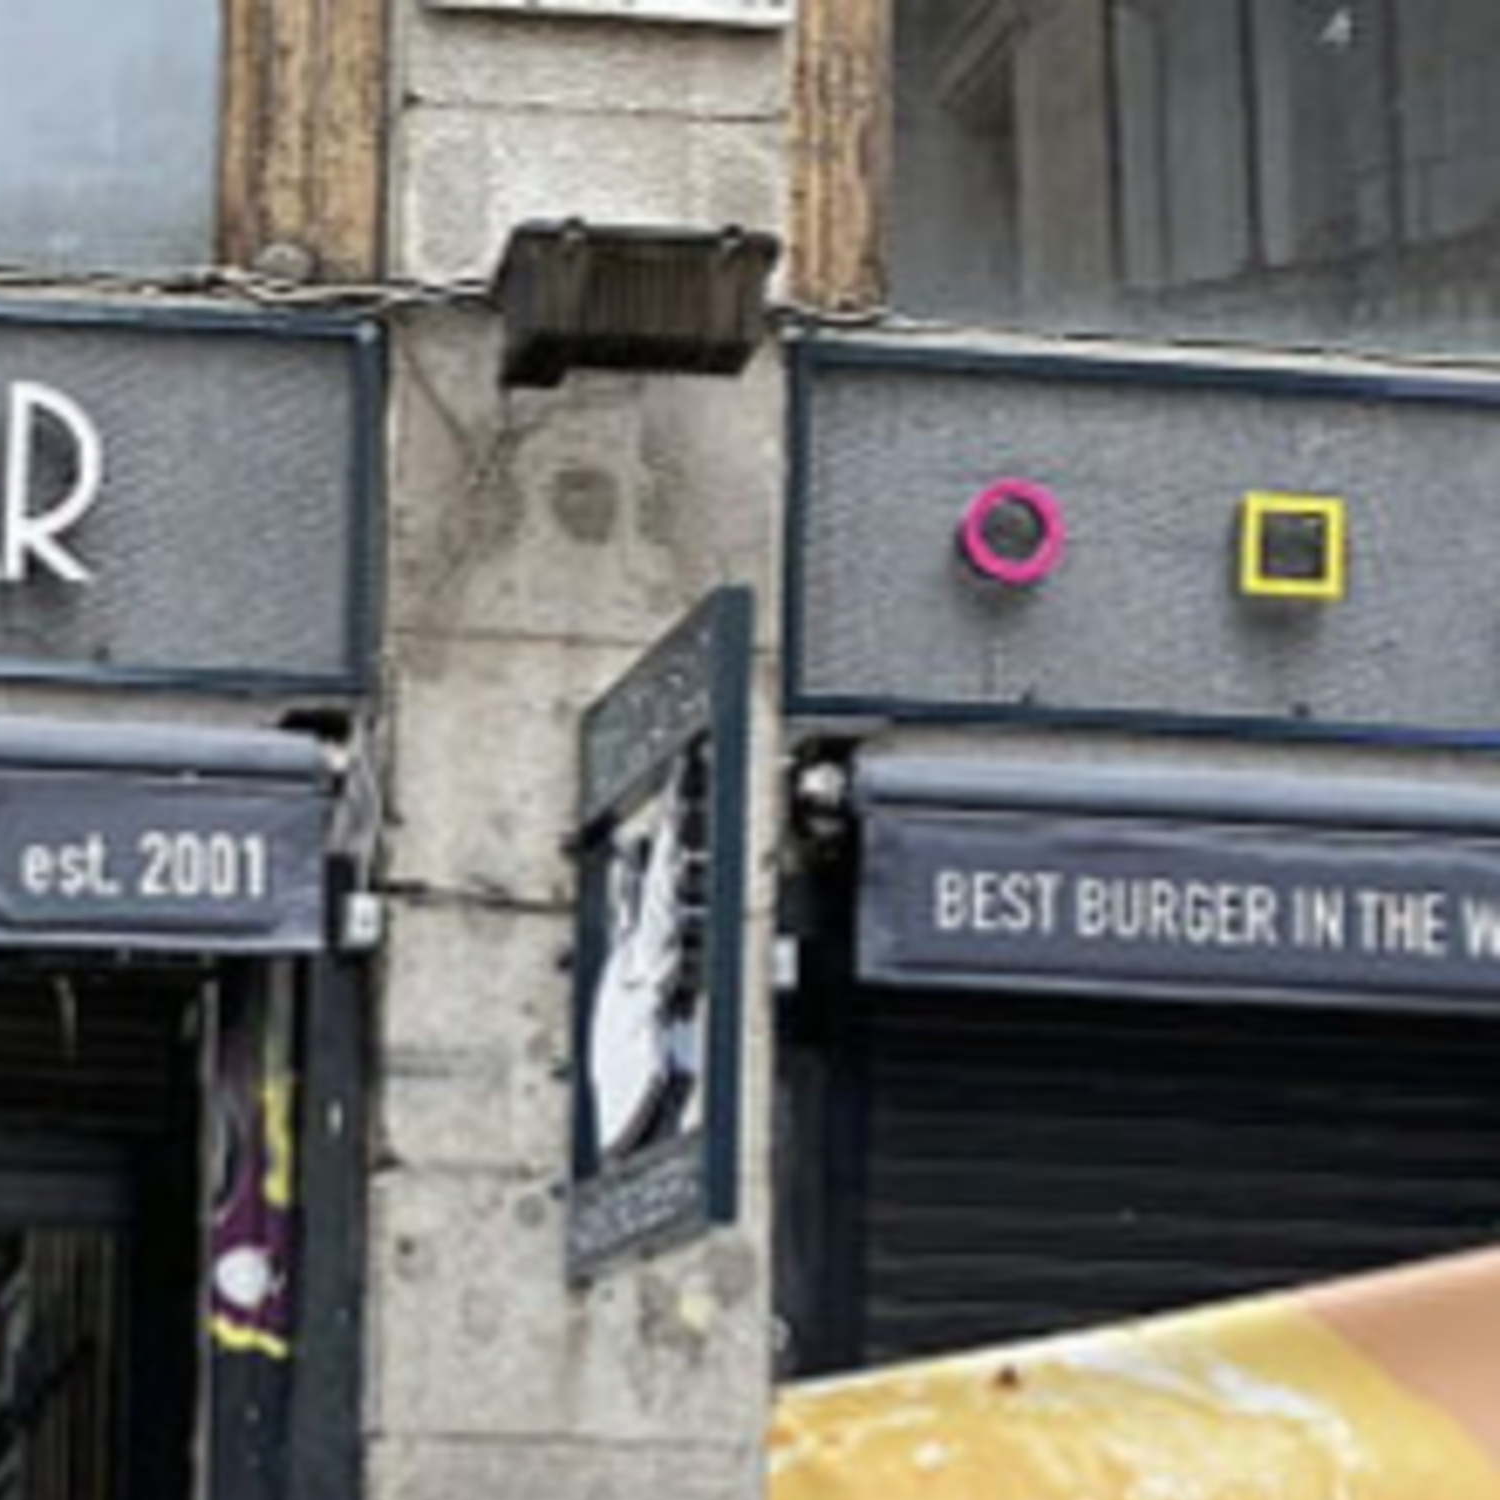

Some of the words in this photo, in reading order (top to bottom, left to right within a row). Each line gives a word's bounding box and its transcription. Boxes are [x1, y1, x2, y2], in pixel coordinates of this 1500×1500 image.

[21, 832, 121, 896] est.
[139, 830, 266, 898] 2001
[935, 870, 1060, 932] BEST
[1075, 877, 1278, 944] BURGER
[1293, 887, 1344, 948] IN
[1357, 890, 1446, 955] THE
